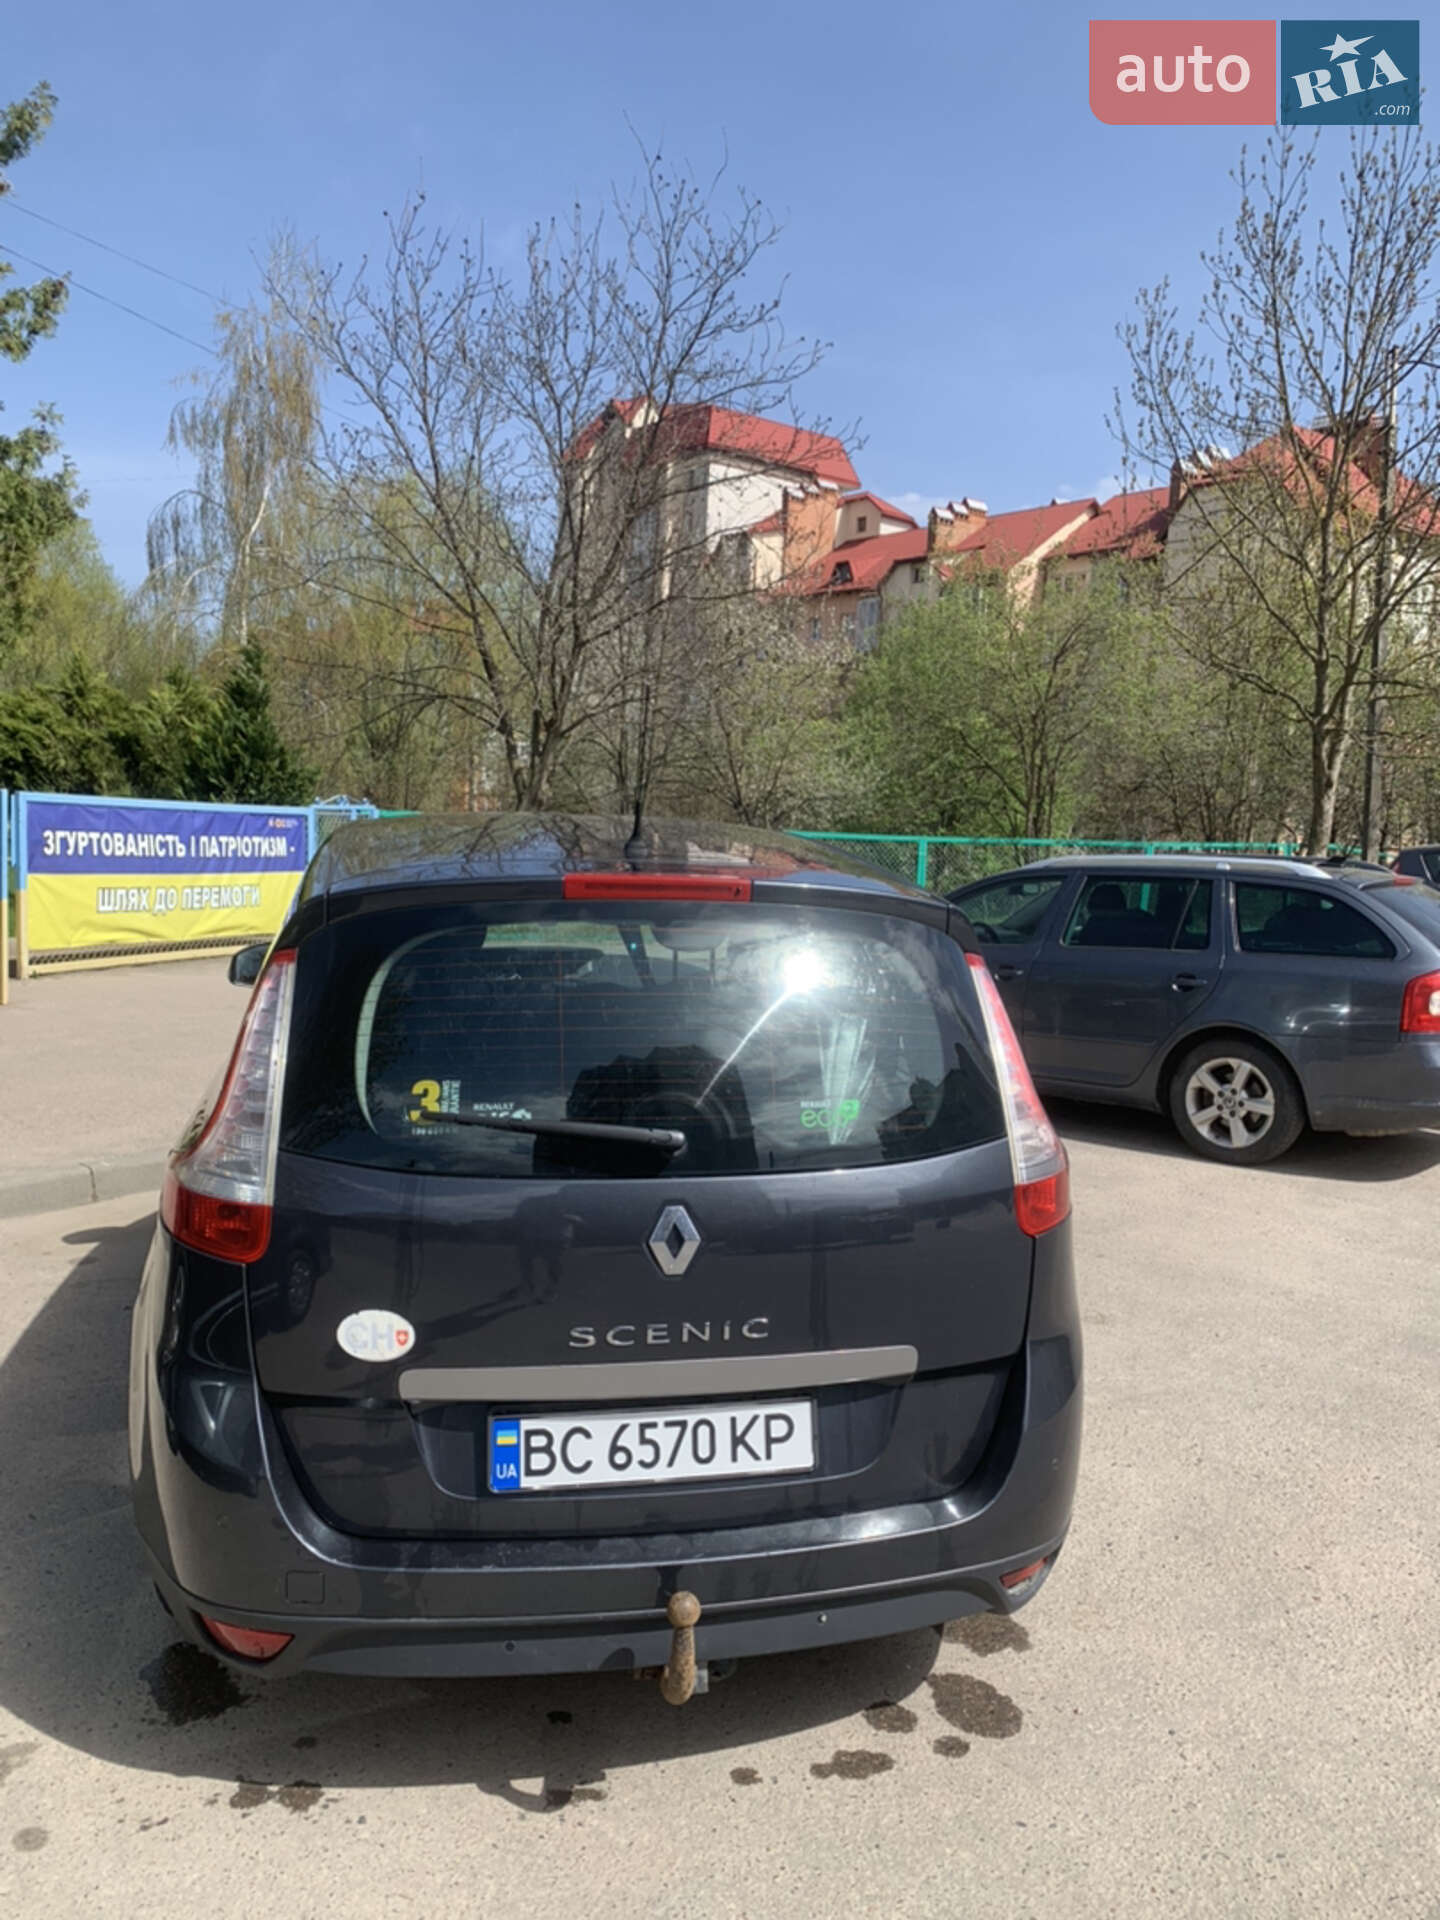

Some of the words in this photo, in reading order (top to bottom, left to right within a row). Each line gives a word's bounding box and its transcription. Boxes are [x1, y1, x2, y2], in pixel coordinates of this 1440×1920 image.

[43, 830, 187, 858] ЗГУРТОВАНІСТЬ
[200, 836, 287, 857] ПАТРІОТИЗМ
[96, 886, 150, 913] ШЛЯХ
[152, 886, 178, 915] ДО
[181, 883, 261, 911] ПЕРЕМОГИ
[344, 1320, 395, 1352] CH
[523, 1426, 593, 1478] BC
[607, 1418, 717, 1472] 6570
[729, 1413, 796, 1463] KP
[495, 1464, 518, 1479] UA
